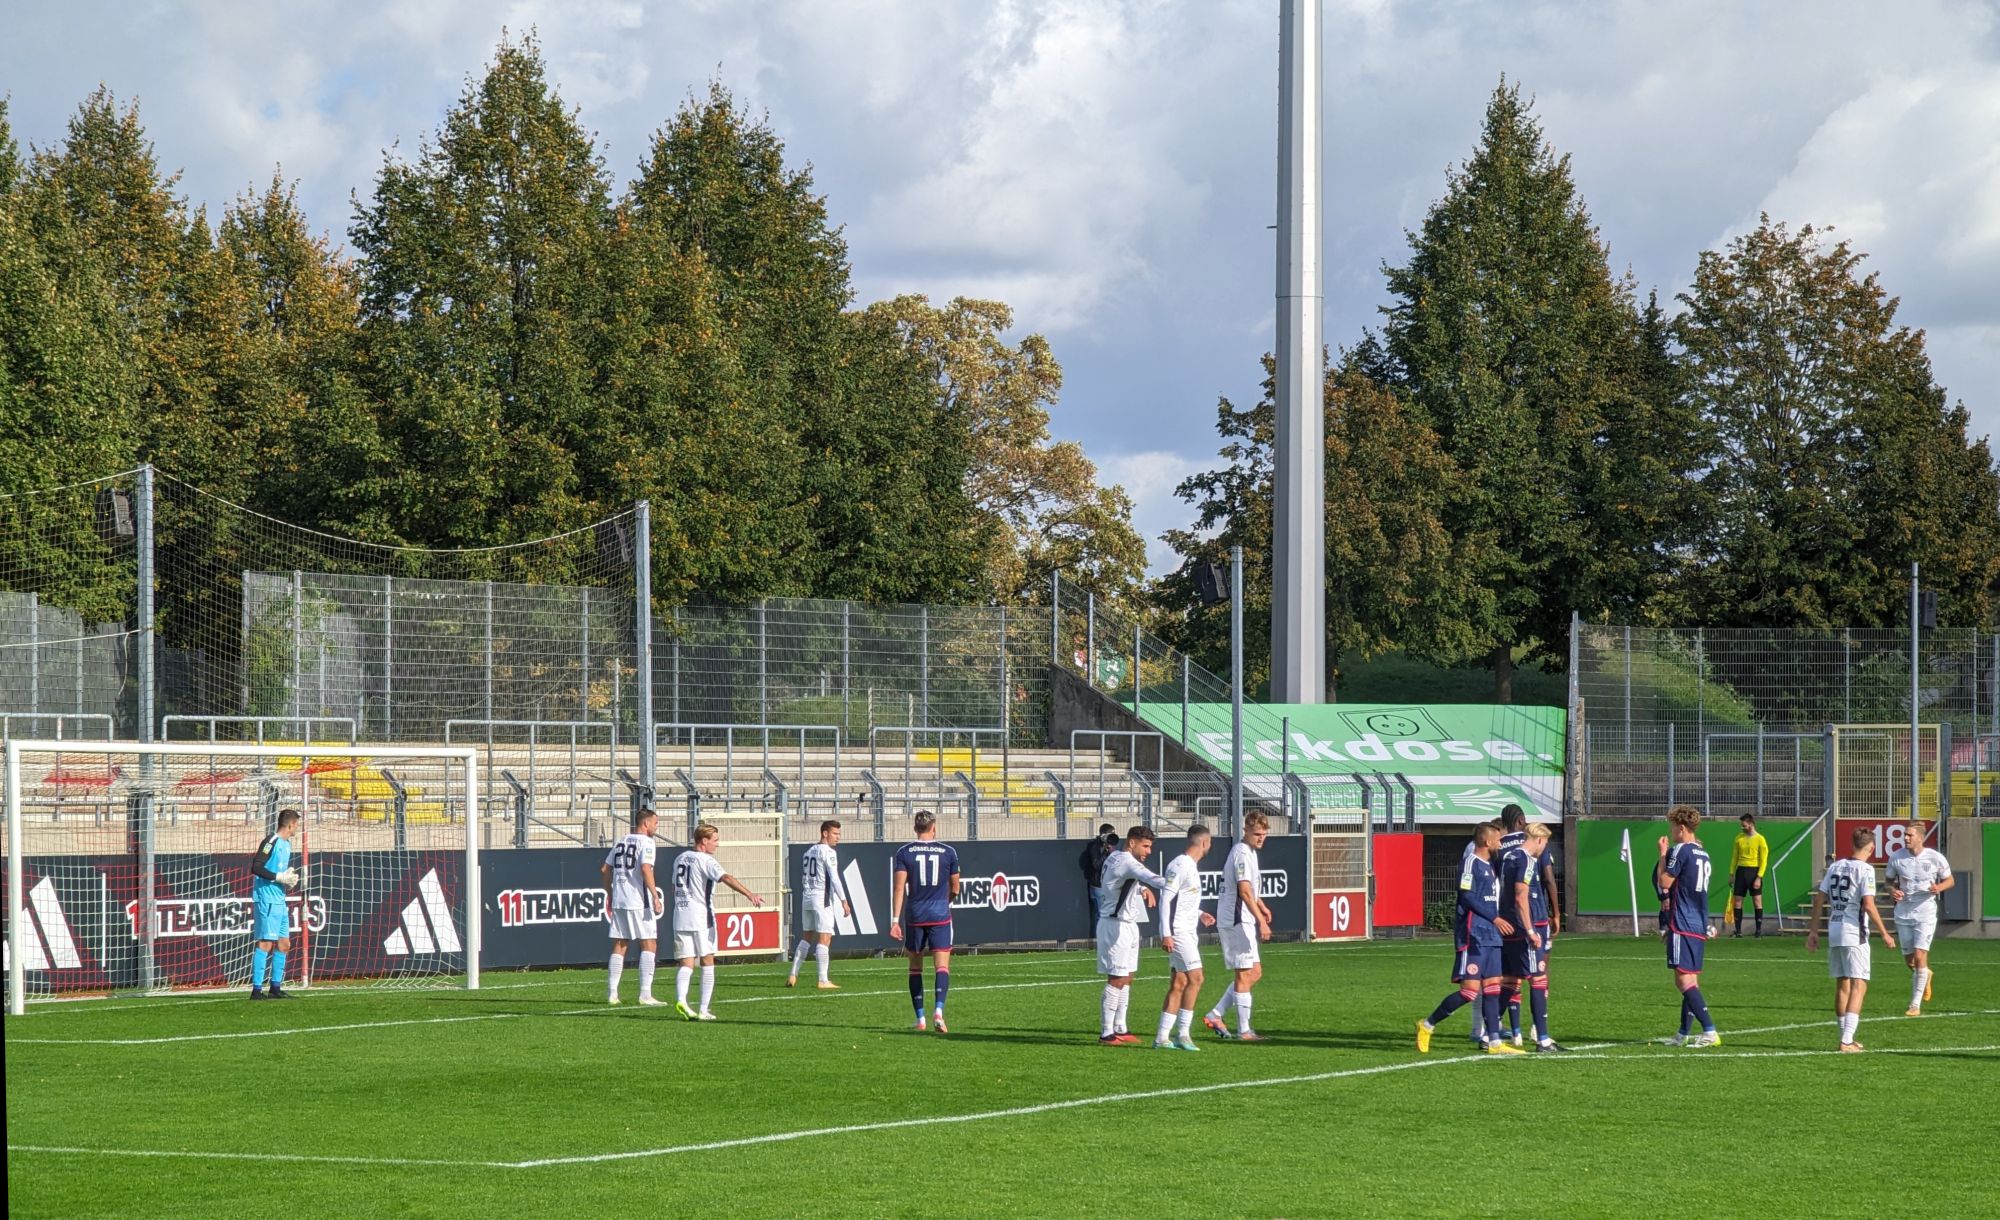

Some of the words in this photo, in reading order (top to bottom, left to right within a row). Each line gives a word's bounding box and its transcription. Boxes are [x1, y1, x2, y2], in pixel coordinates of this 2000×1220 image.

[1194, 732, 1554, 762] Eckdose.
[1873, 824, 1906, 858] 18
[614, 843, 637, 870] 28
[803, 856, 817, 877] 20
[915, 855, 939, 886] 11
[676, 864, 691, 888] 21
[1696, 858, 1712, 894] 18
[1830, 874, 1851, 902] 22
[1329, 896, 1350, 931] 19
[727, 914, 753, 947] 20
